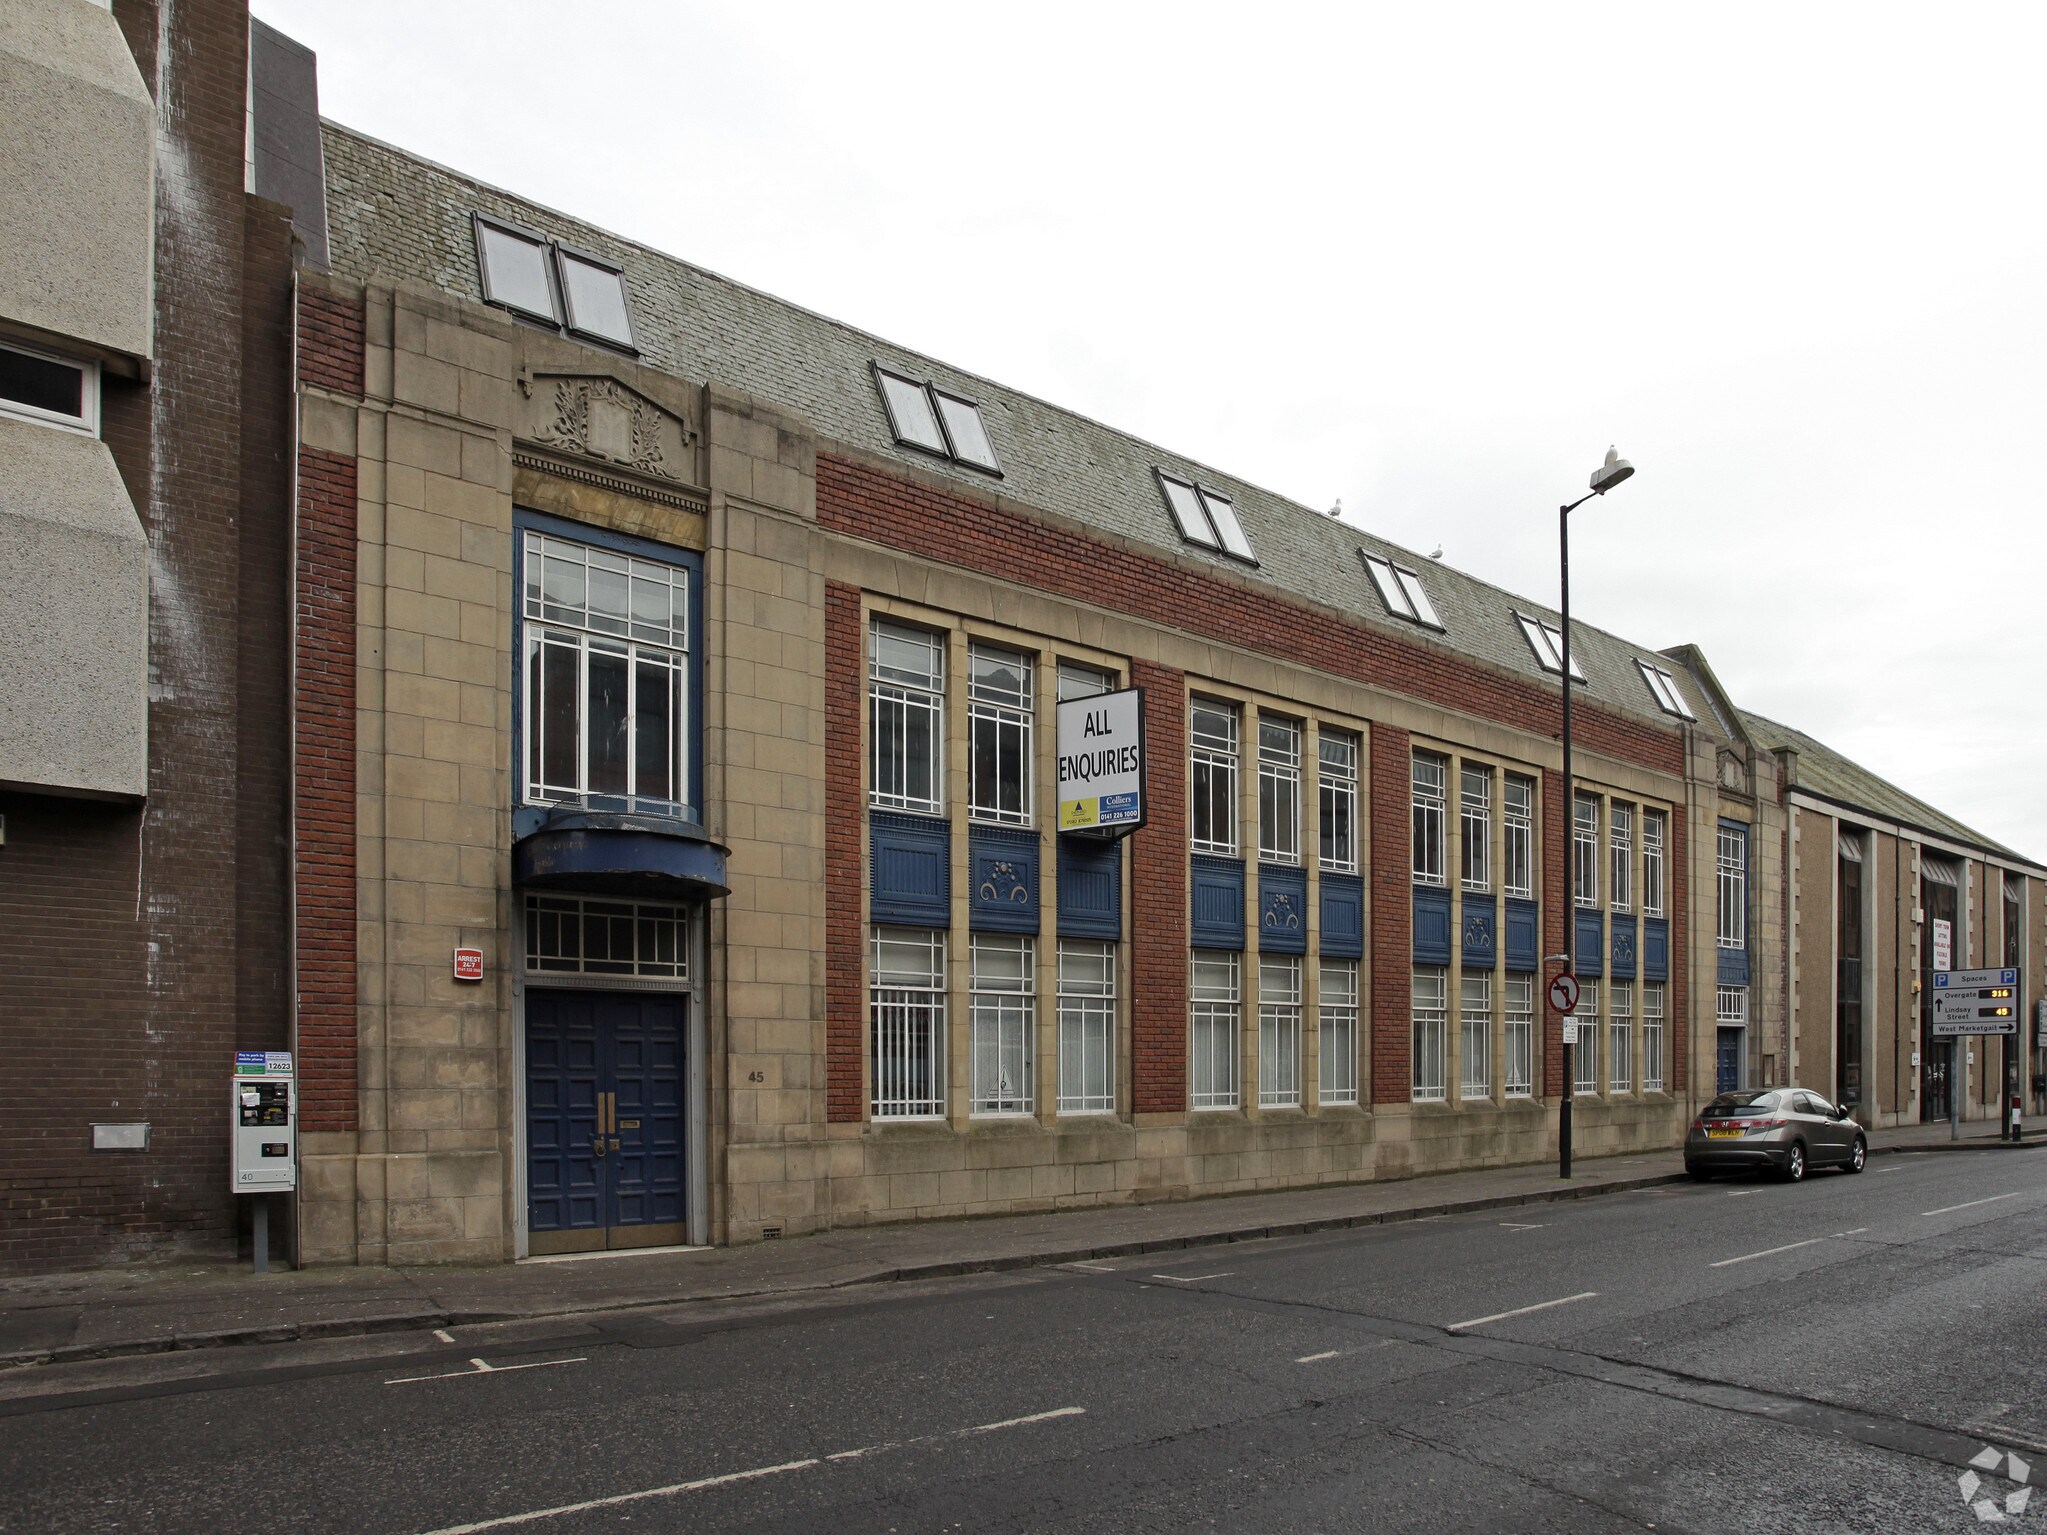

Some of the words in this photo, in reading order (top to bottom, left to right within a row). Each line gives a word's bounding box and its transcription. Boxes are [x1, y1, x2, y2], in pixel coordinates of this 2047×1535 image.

[1084, 709, 1112, 738] ALL
[1059, 745, 1138, 783] ENQUIRIES
[1106, 795, 1132, 806] Colliers
[1100, 812, 1112, 820] 0141
[457, 955, 481, 963] ARREST
[1944, 991, 1977, 999] Overgate
[1991, 989, 2009, 998] 316
[1944, 1006, 1971, 1014] Lindsay
[1996, 1008, 2008, 1016] 45
[1958, 1024, 1997, 1032] Marketgait
[269, 1062, 291, 1070] 12623
[748, 1071, 764, 1083] 45
[241, 1173, 254, 1181] 40
